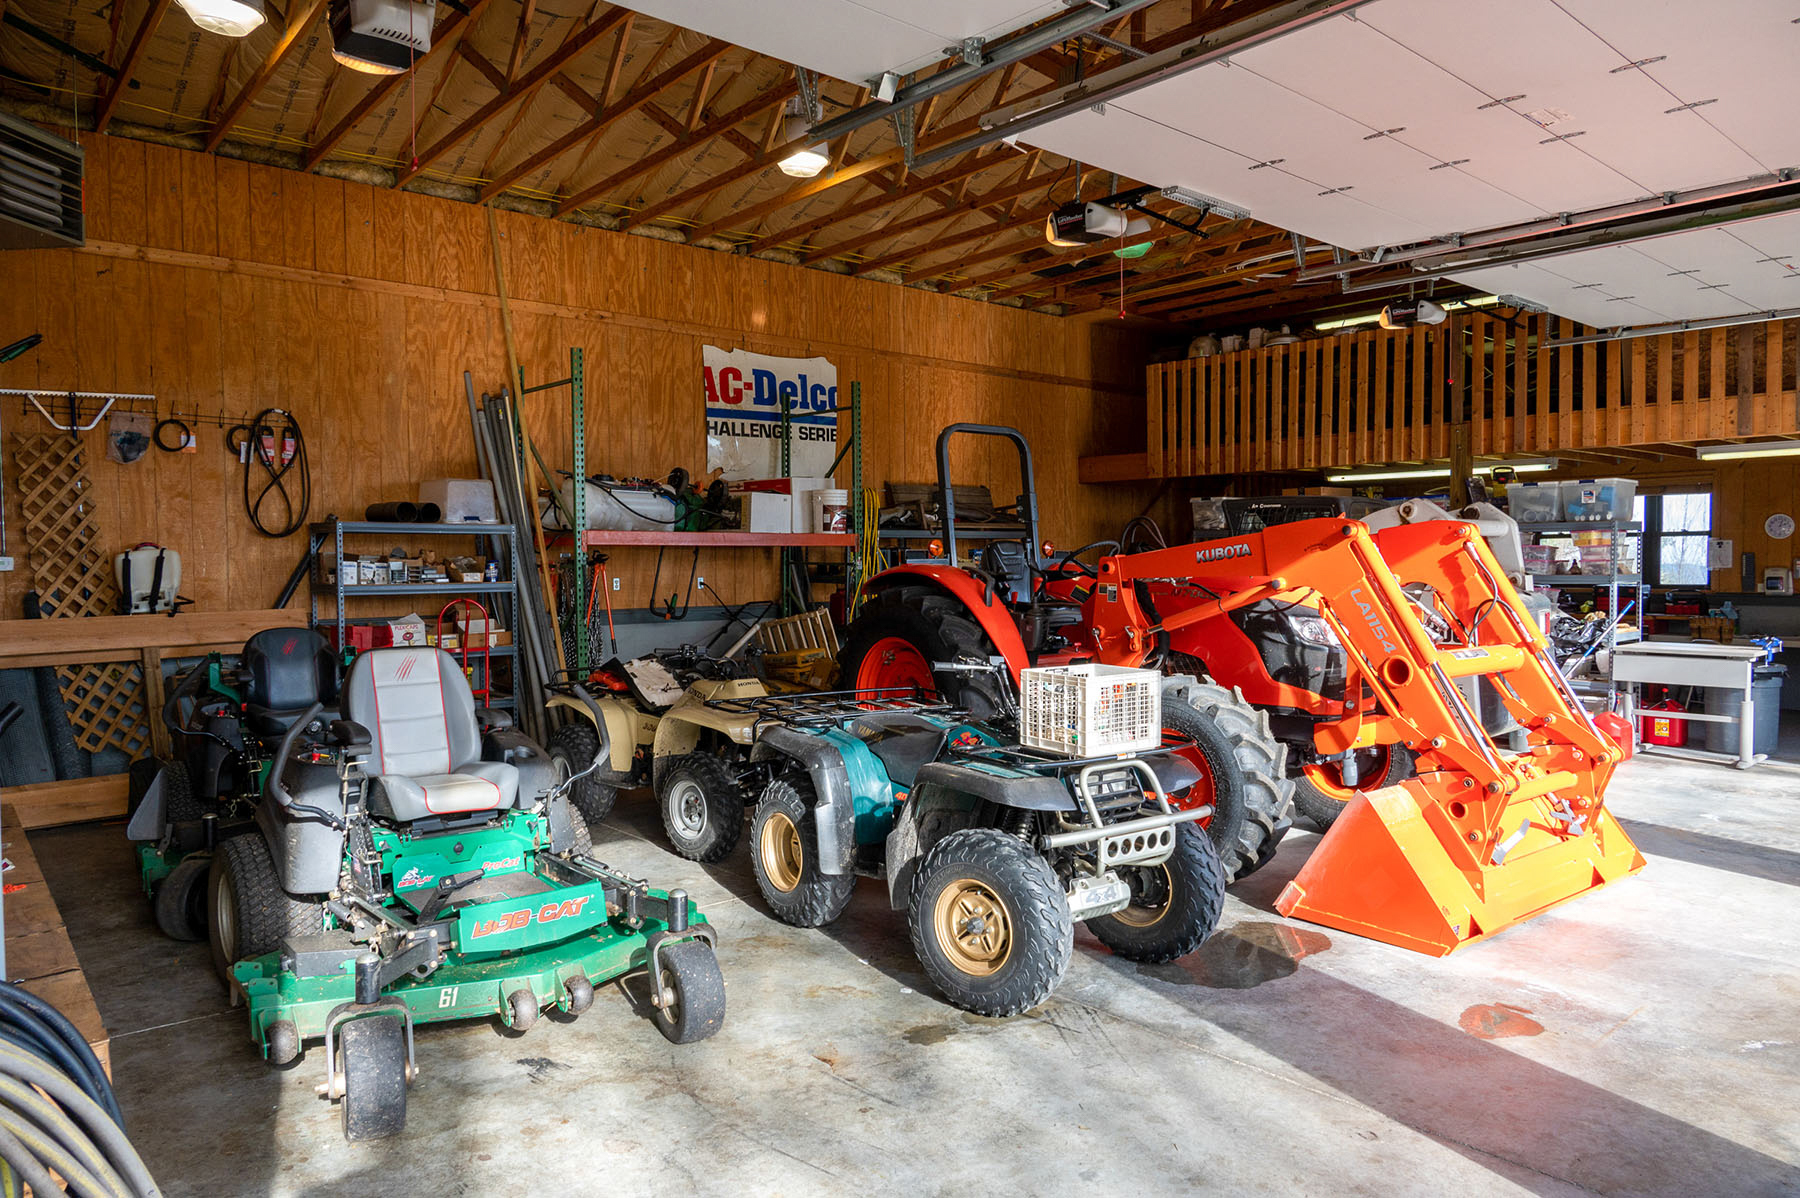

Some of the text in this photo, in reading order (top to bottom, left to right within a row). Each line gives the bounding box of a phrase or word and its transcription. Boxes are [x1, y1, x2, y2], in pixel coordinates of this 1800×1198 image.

[707, 420, 837, 442] HALLENG SERIE
[1196, 543, 1252, 563] KUBOTA
[1350, 588, 1397, 653] LA1154
[737, 680, 760, 688] HONDA
[482, 856, 521, 871] ProCat
[471, 895, 590, 940] BOB-CAT
[438, 986, 459, 1009] 61
